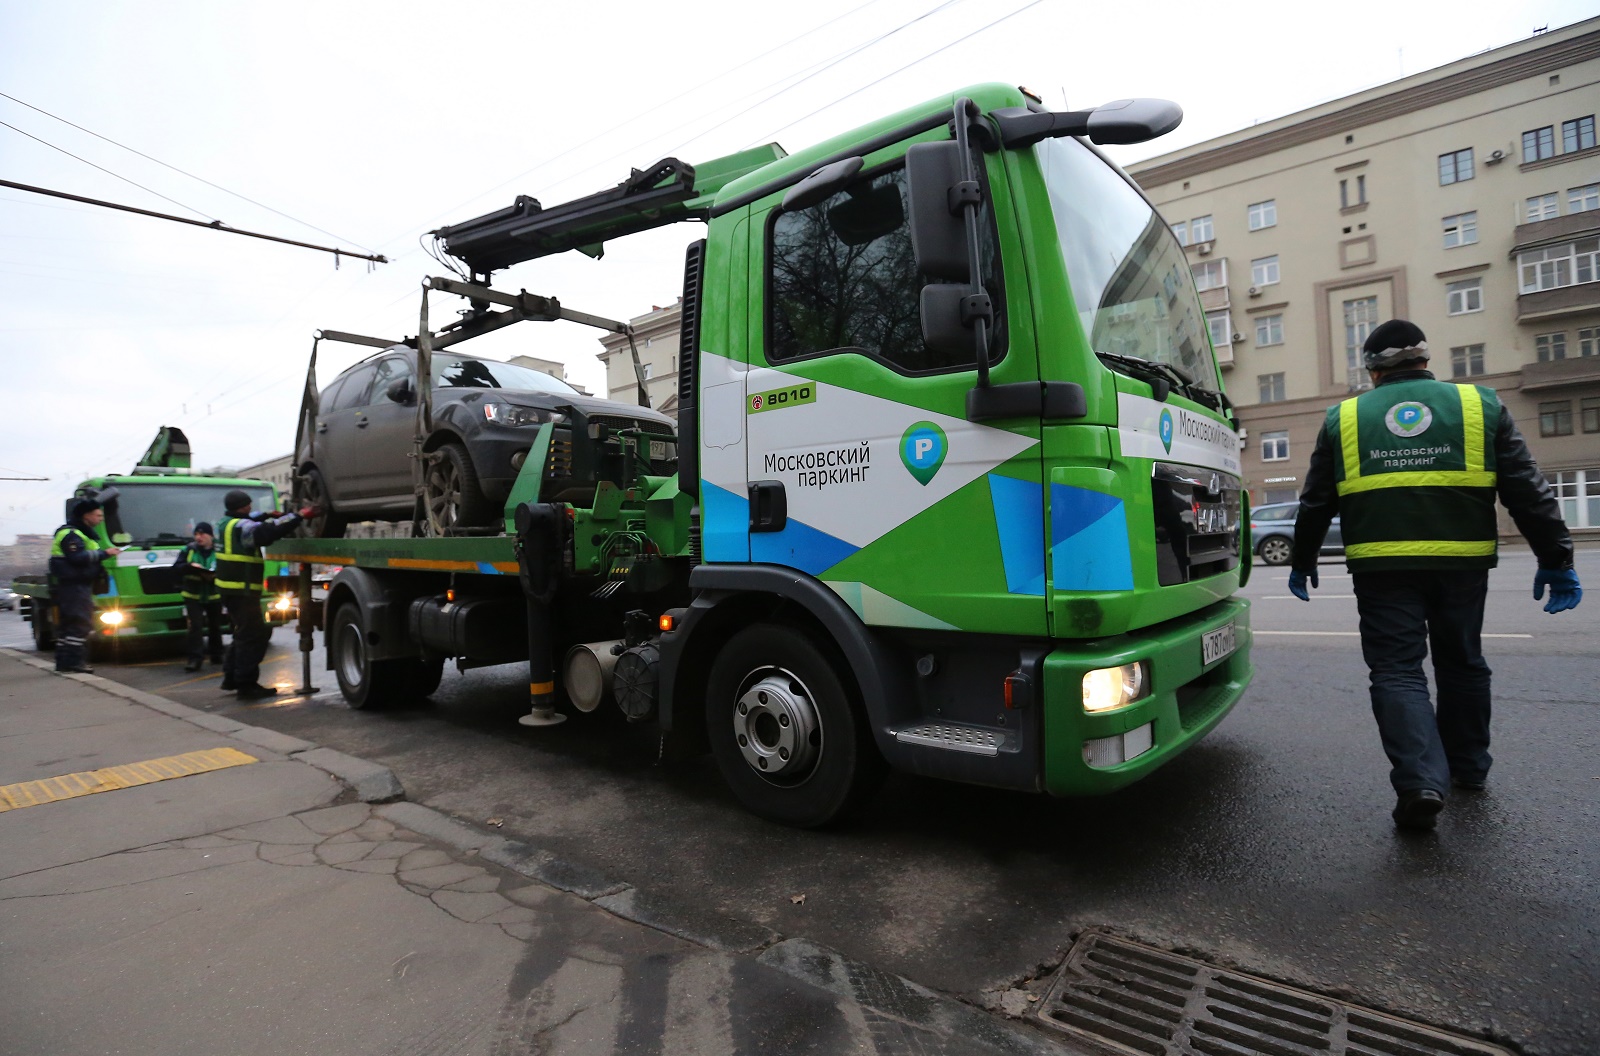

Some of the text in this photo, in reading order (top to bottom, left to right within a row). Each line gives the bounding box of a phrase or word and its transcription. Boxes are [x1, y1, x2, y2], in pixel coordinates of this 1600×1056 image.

[767, 387, 811, 406] 8010
[1404, 410, 1416, 421] P
[1179, 410, 1221, 445] Московский
[764, 441, 870, 474] Московский
[915, 438, 933, 460] P
[1370, 443, 1451, 460] Московский
[1384, 456, 1437, 468] паркинг
[798, 466, 870, 491] паркинг
